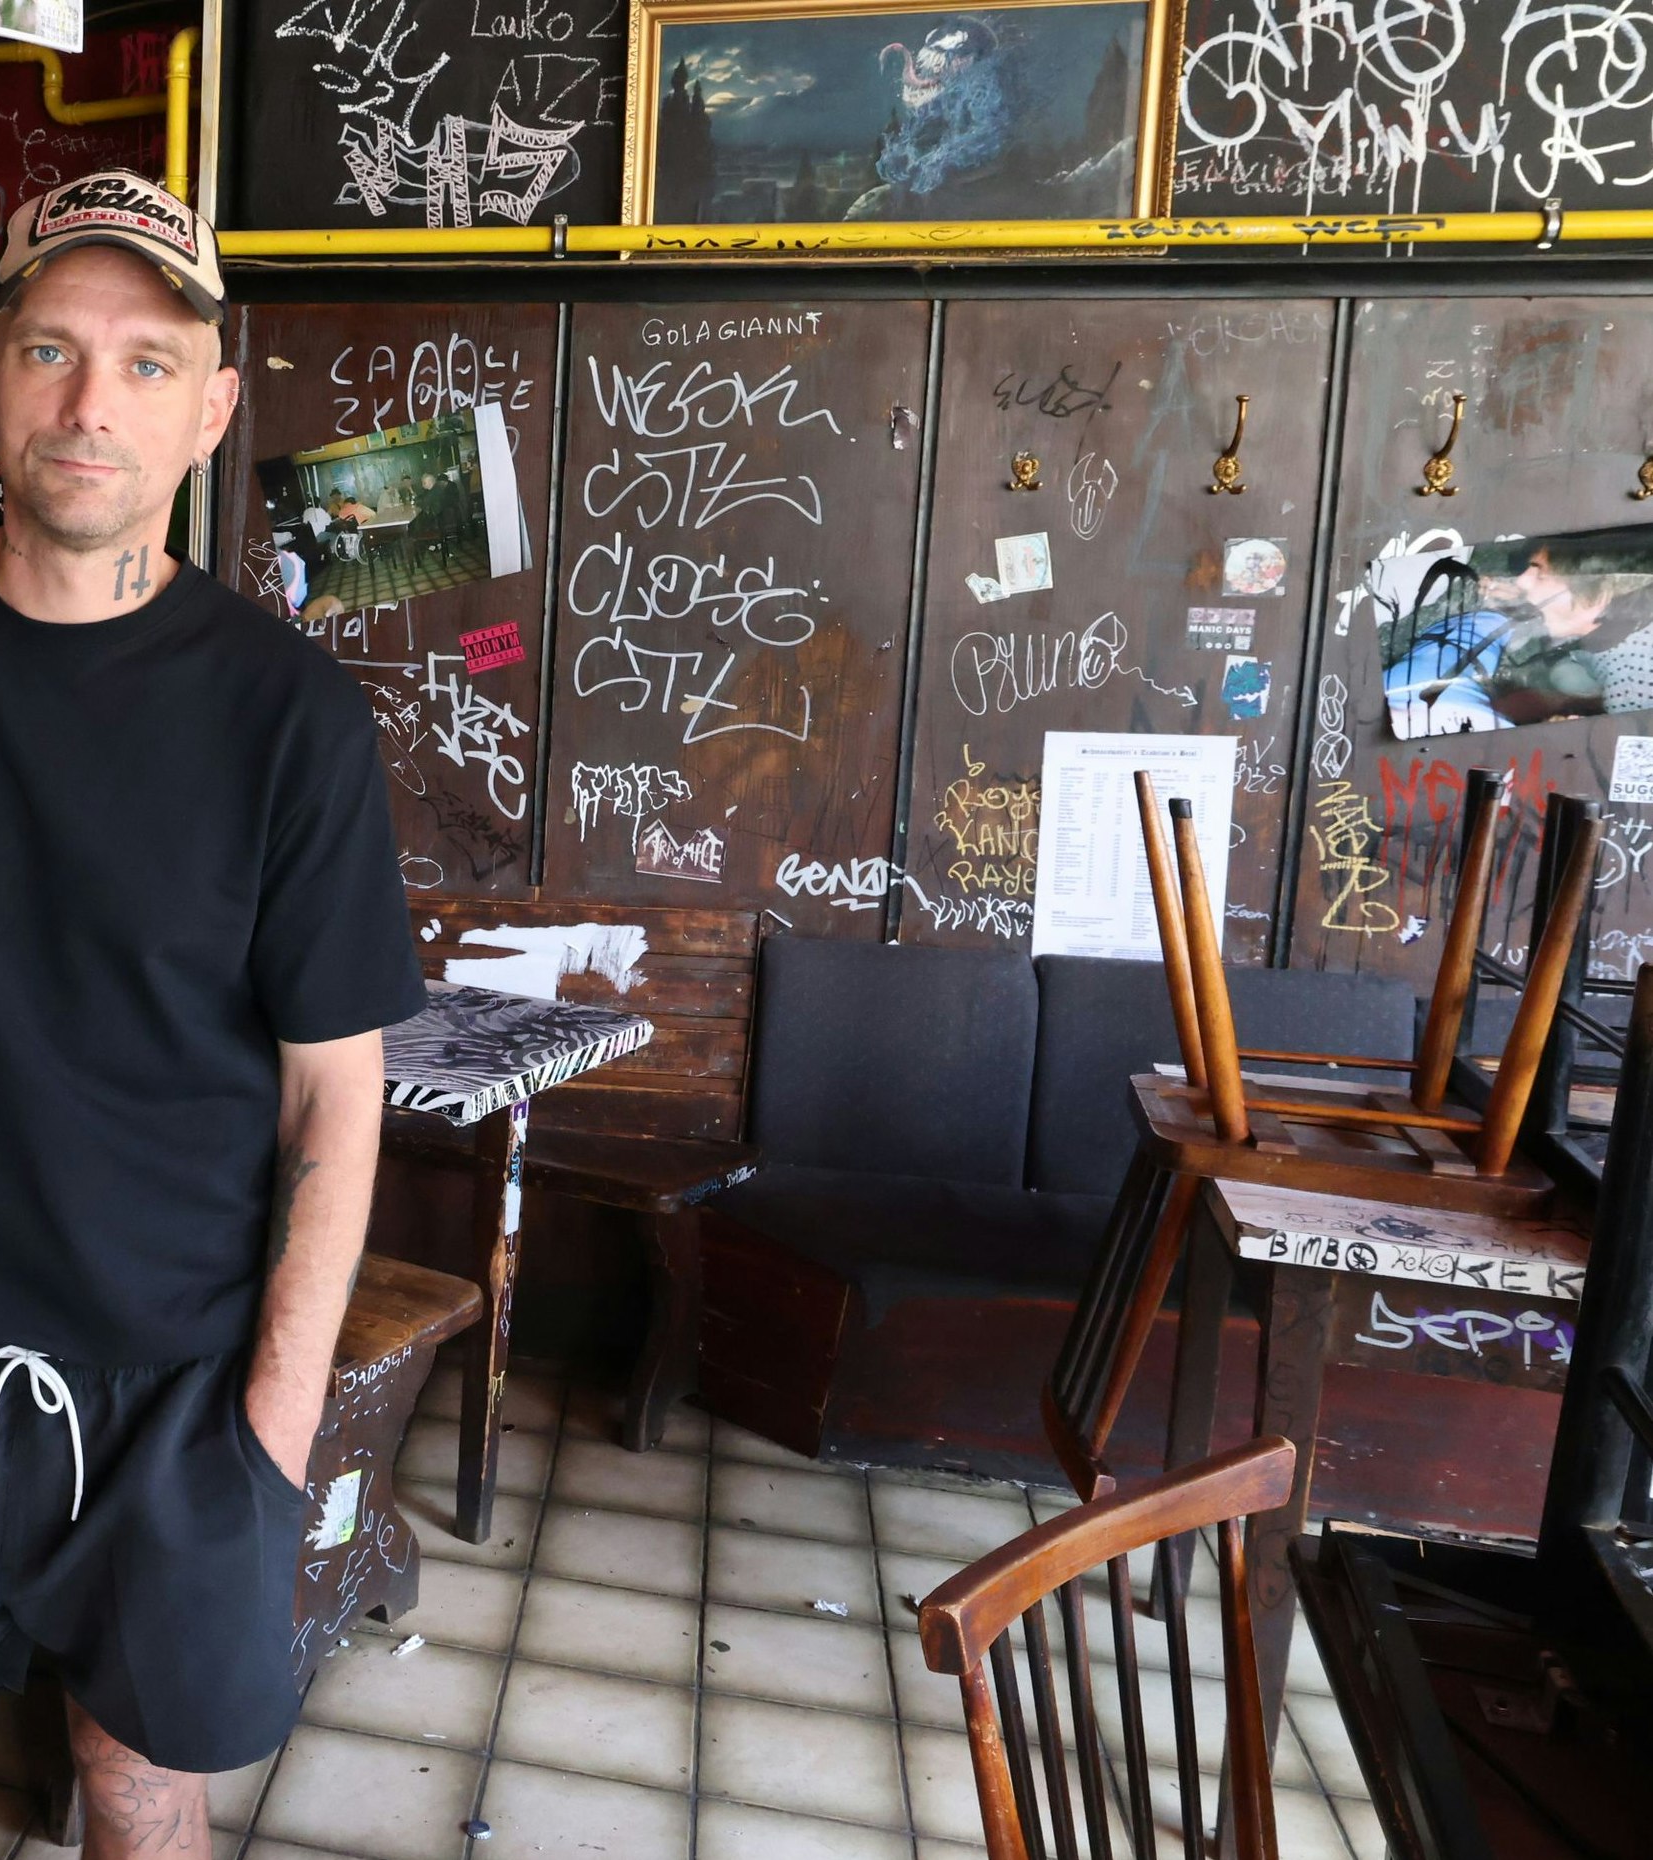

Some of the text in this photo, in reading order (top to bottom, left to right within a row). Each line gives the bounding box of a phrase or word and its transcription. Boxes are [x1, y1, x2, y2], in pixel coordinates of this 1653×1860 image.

[1189, 625, 1223, 633] MANIC
[465, 633, 520, 660] ANONYM
[1613, 783, 1653, 794] SUG
